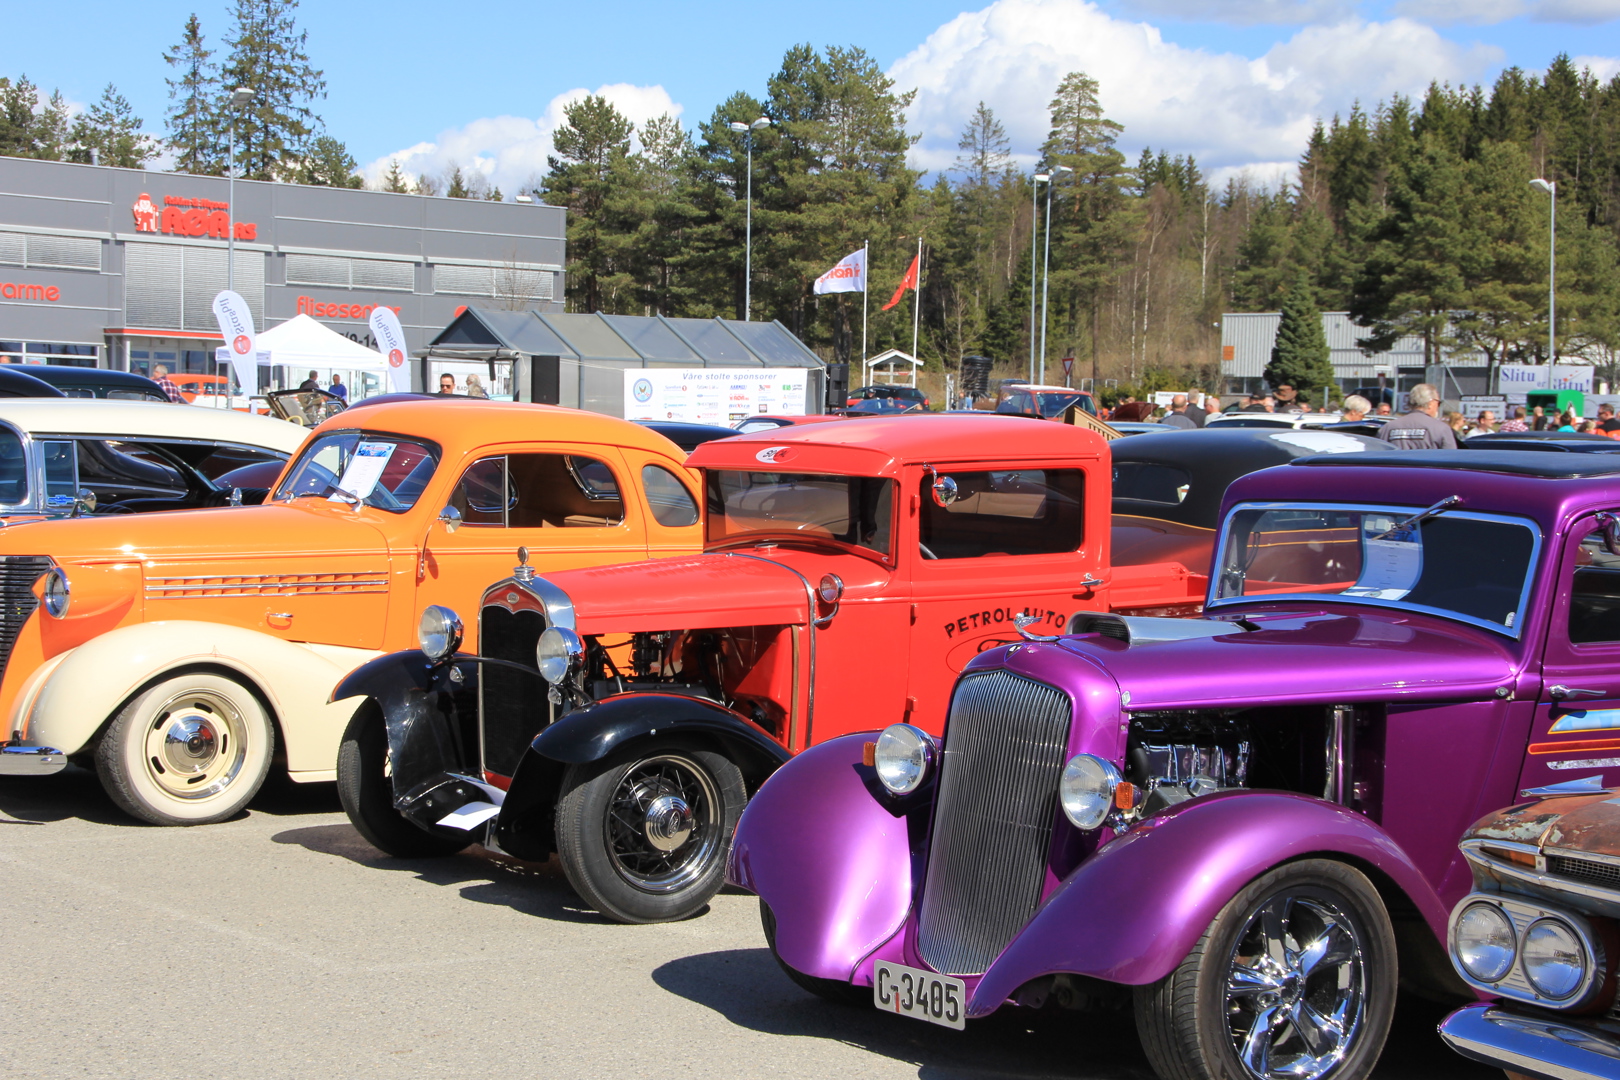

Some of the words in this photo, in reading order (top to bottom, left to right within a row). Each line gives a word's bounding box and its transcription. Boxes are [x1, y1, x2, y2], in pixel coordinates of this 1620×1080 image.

[233, 222, 257, 239] AS
[0, 282, 61, 301] arme
[682, 372, 703, 380] Våre
[705, 373, 731, 381] stolte
[733, 373, 777, 382] sponsorer
[1501, 368, 1535, 382] Slitu
[944, 607, 1015, 638] PETROL
[1022, 607, 1066, 628] AUTO
[878, 967, 959, 1022] C-3405
